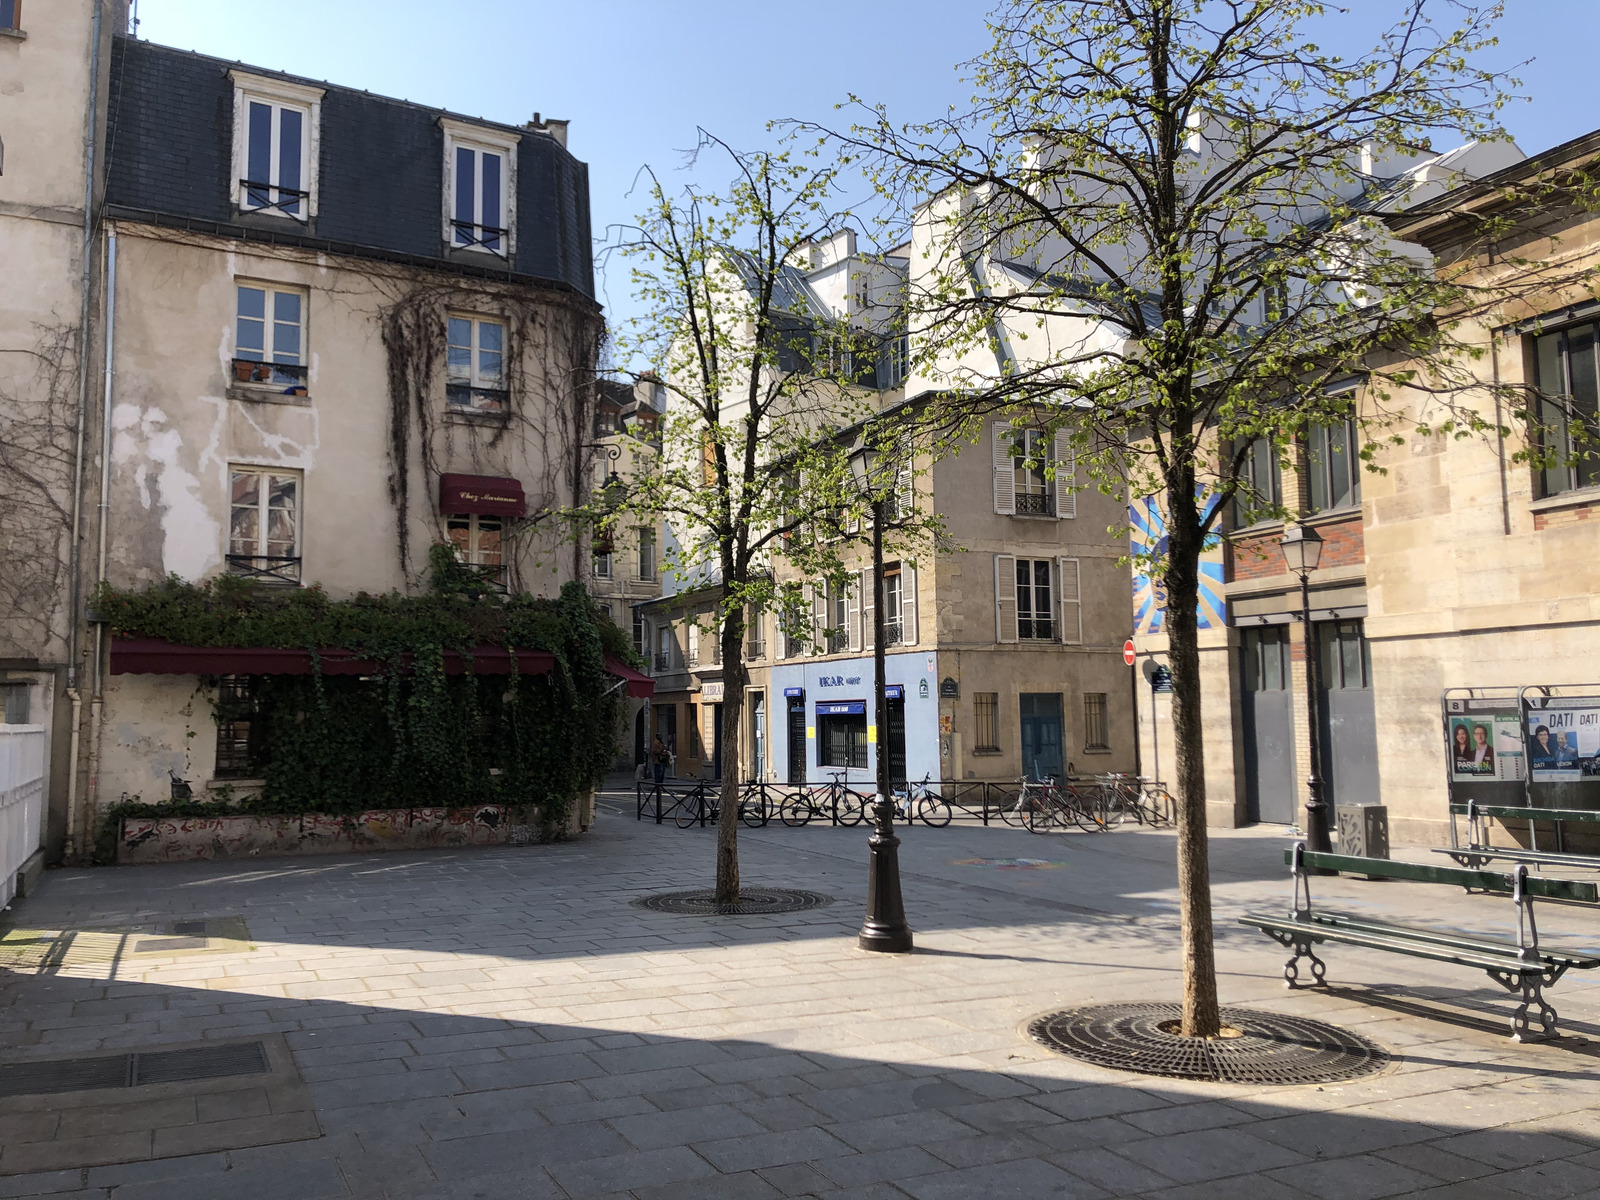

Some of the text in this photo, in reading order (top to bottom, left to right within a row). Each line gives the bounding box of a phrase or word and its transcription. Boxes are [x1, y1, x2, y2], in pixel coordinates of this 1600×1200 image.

[460, 491, 518, 503] Chez Marianne
[818, 675, 845, 688] IKAR
[1452, 702, 1460, 710] 8
[1549, 712, 1574, 728] DATI
[1579, 713, 1598, 726] DATI
